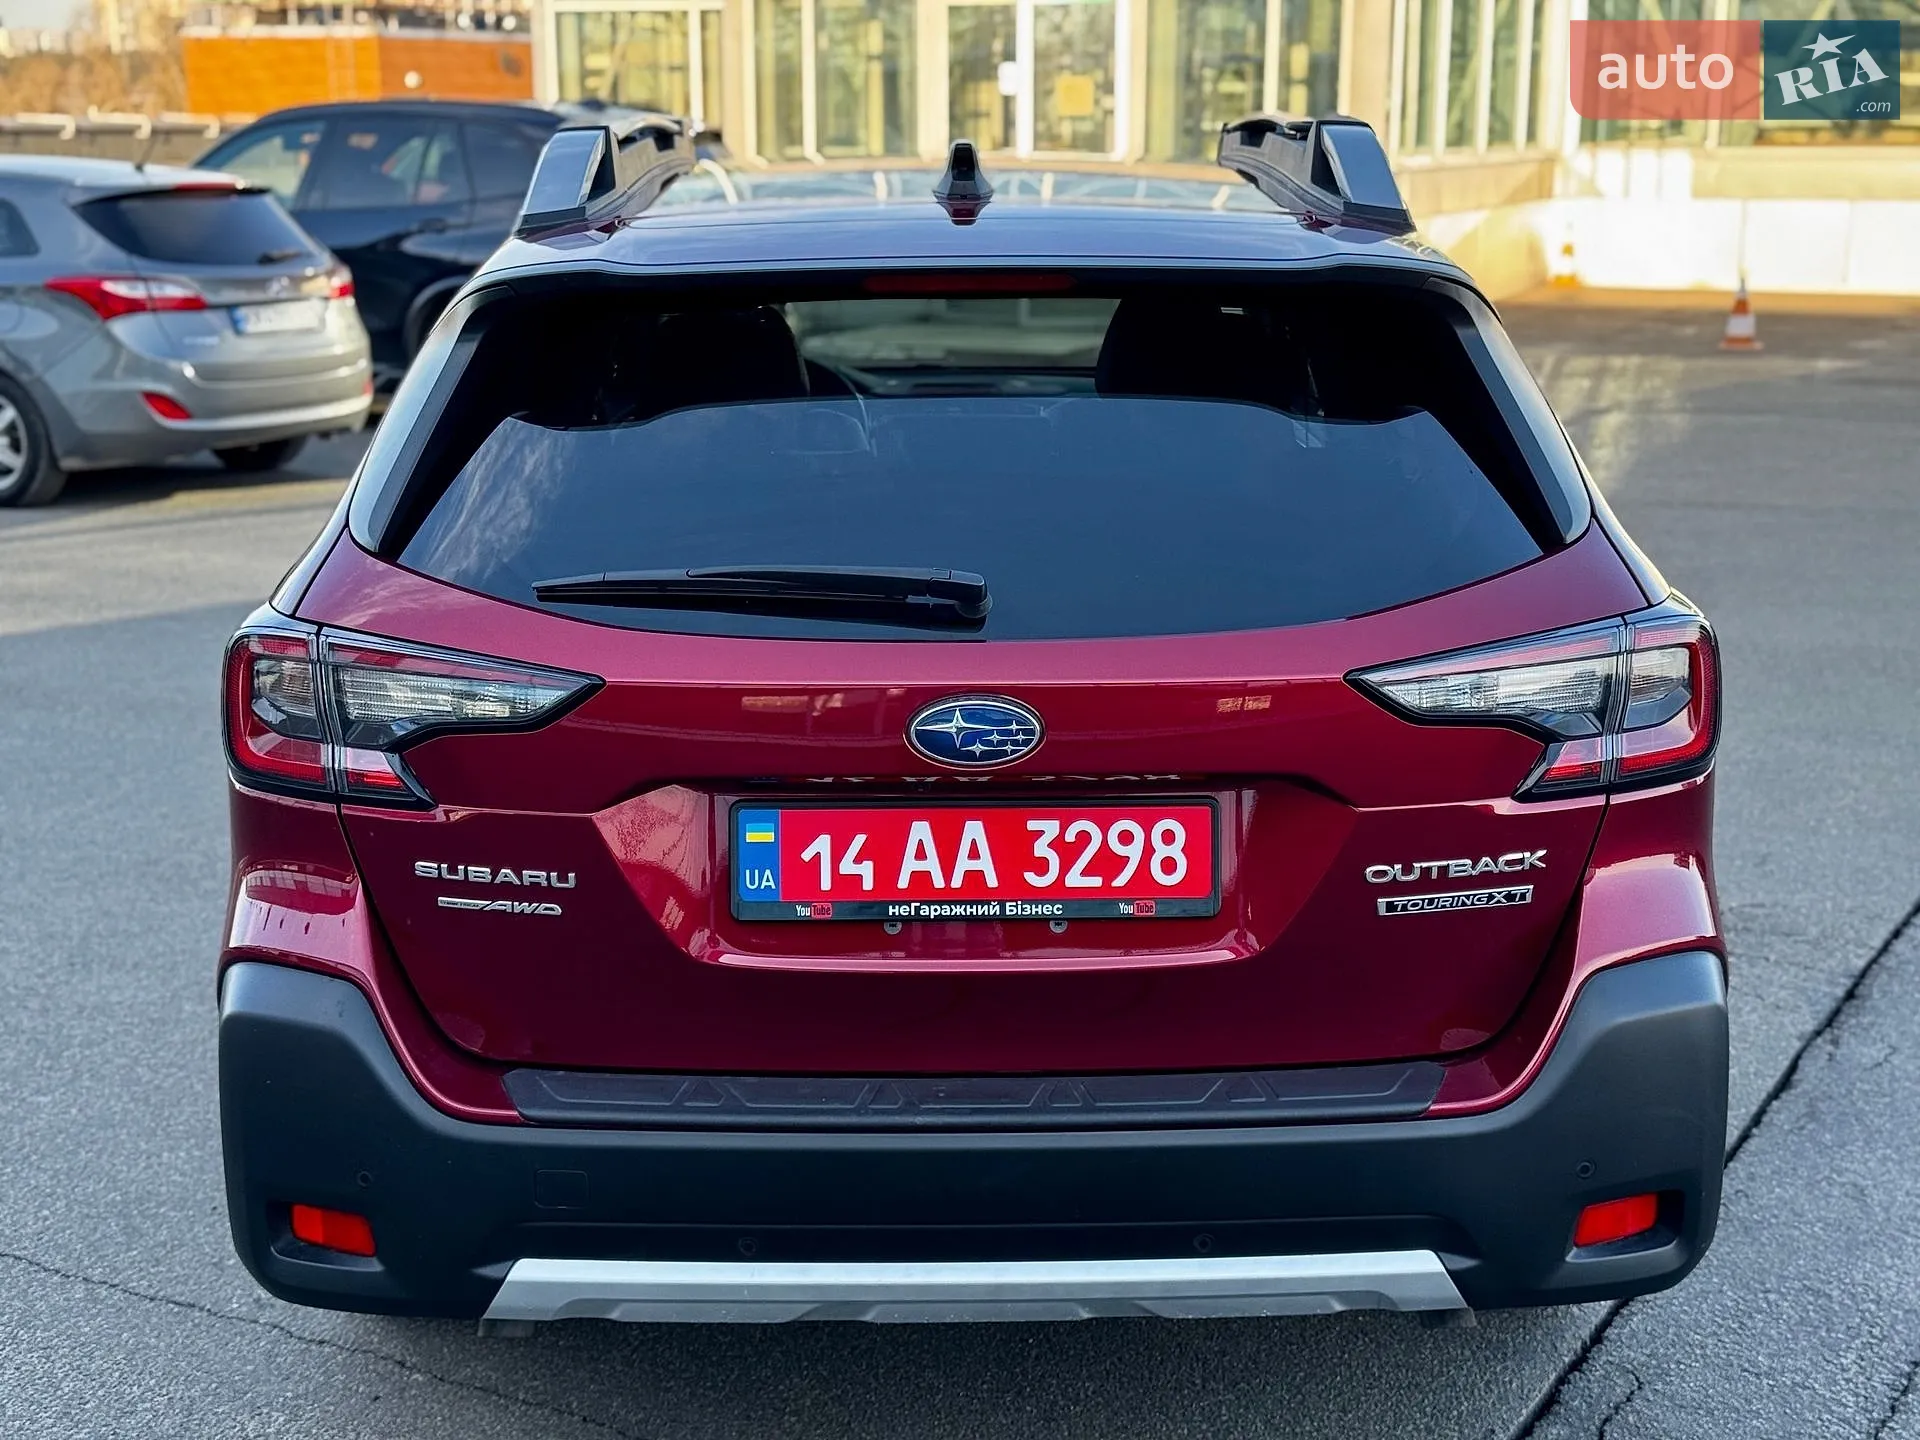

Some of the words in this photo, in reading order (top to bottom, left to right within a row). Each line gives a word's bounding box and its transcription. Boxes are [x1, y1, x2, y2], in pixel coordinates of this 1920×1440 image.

[800, 833, 874, 892] 14
[896, 819, 999, 890] AA
[1022, 817, 1188, 889] 3298
[1364, 849, 1548, 884] OUTBACK
[414, 860, 577, 889] SUBARU
[745, 868, 776, 890] UA
[483, 899, 563, 916] AWD
[888, 901, 1000, 919] неГаражний
[1005, 900, 1063, 916] Бізнес
